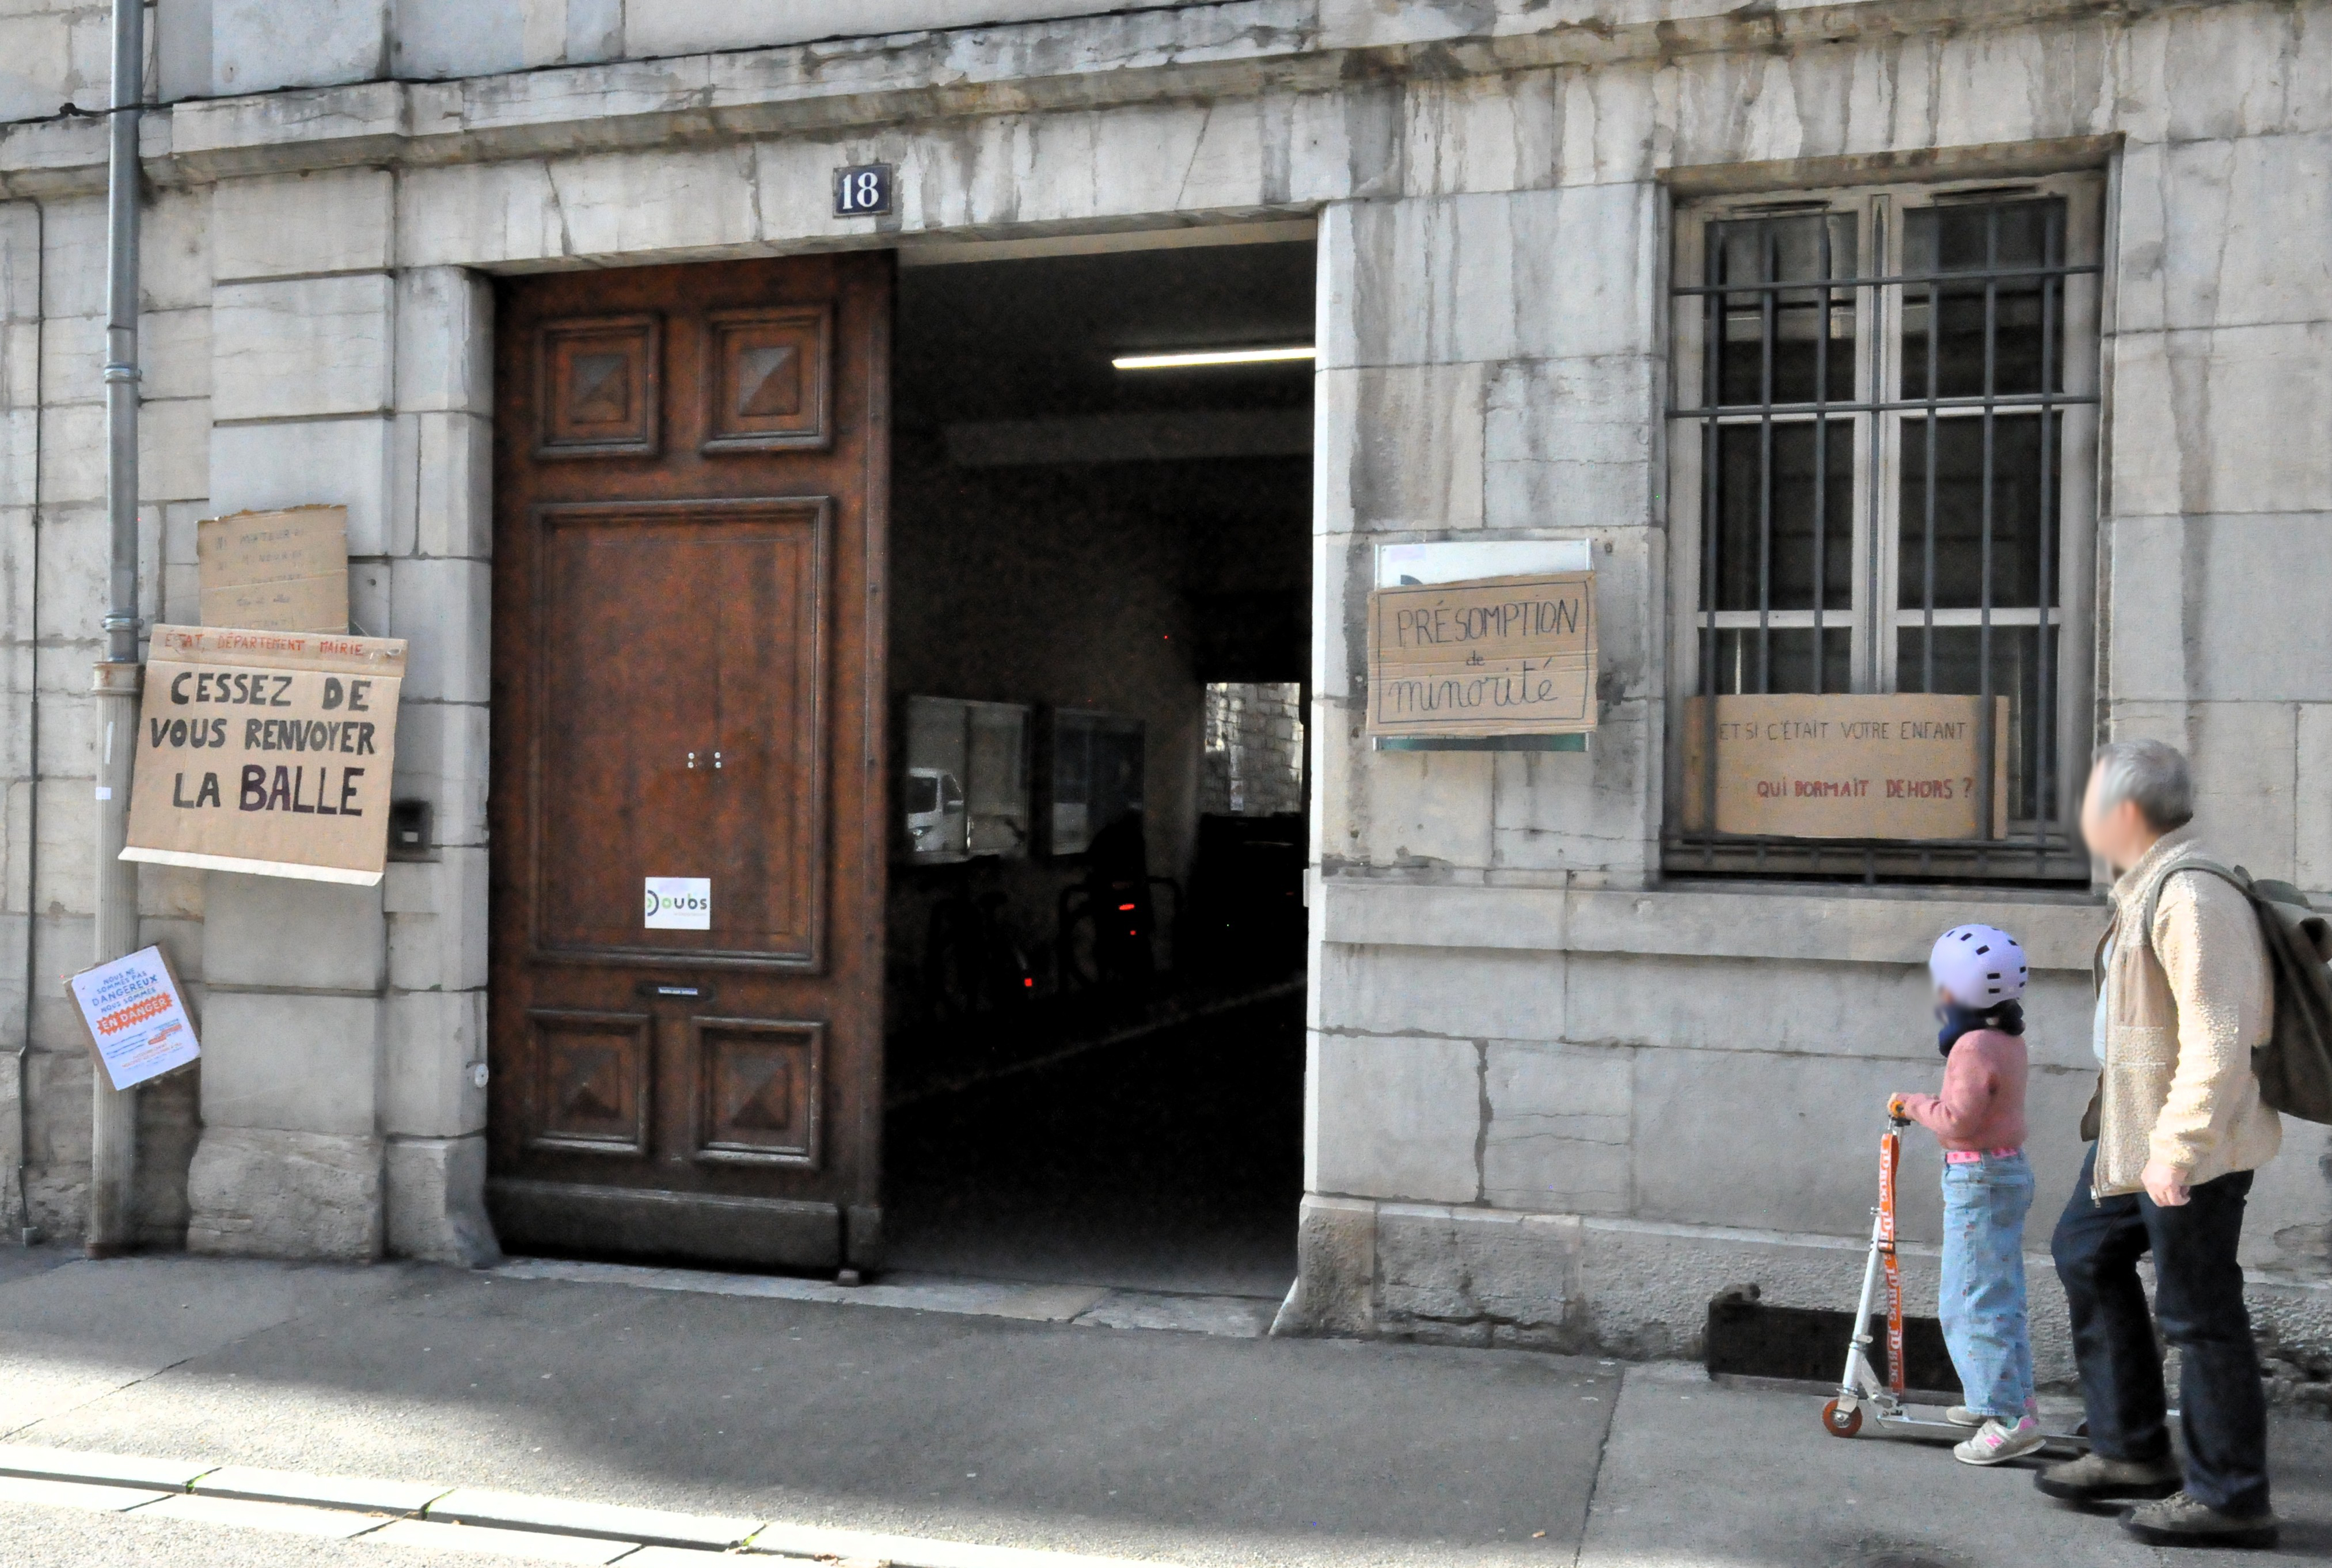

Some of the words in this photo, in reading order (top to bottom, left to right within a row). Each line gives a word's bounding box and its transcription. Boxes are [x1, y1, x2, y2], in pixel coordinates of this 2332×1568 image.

[843, 172, 879, 209] 18
[1397, 595, 1578, 647] PRÉSOMPTION
[218, 633, 305, 651] DÉPARTEMENT
[1466, 650, 1485, 666] de
[171, 671, 292, 707] CESSEZ
[321, 677, 371, 712] DE
[1388, 656, 1558, 712] minorité
[150, 717, 227, 749] VOUS
[244, 719, 375, 755] RENVOYER
[1720, 723, 1741, 740] ET
[1841, 722, 1889, 739] VOTRE
[1901, 721, 1966, 739] ENFANT
[173, 772, 221, 808] LA
[239, 765, 364, 817] BALLE
[1886, 779, 1953, 799] DEHORS
[92, 974, 157, 1006] DANGEREUX
[97, 978, 130, 994] SOMMES
[131, 971, 147, 979] PAS
[103, 973, 123, 985] NOUS
[101, 1001, 121, 1012] NOUS
[123, 987, 156, 1004] SOMMES
[102, 1018, 118, 1029] EN
[120, 998, 166, 1022] DANGER
